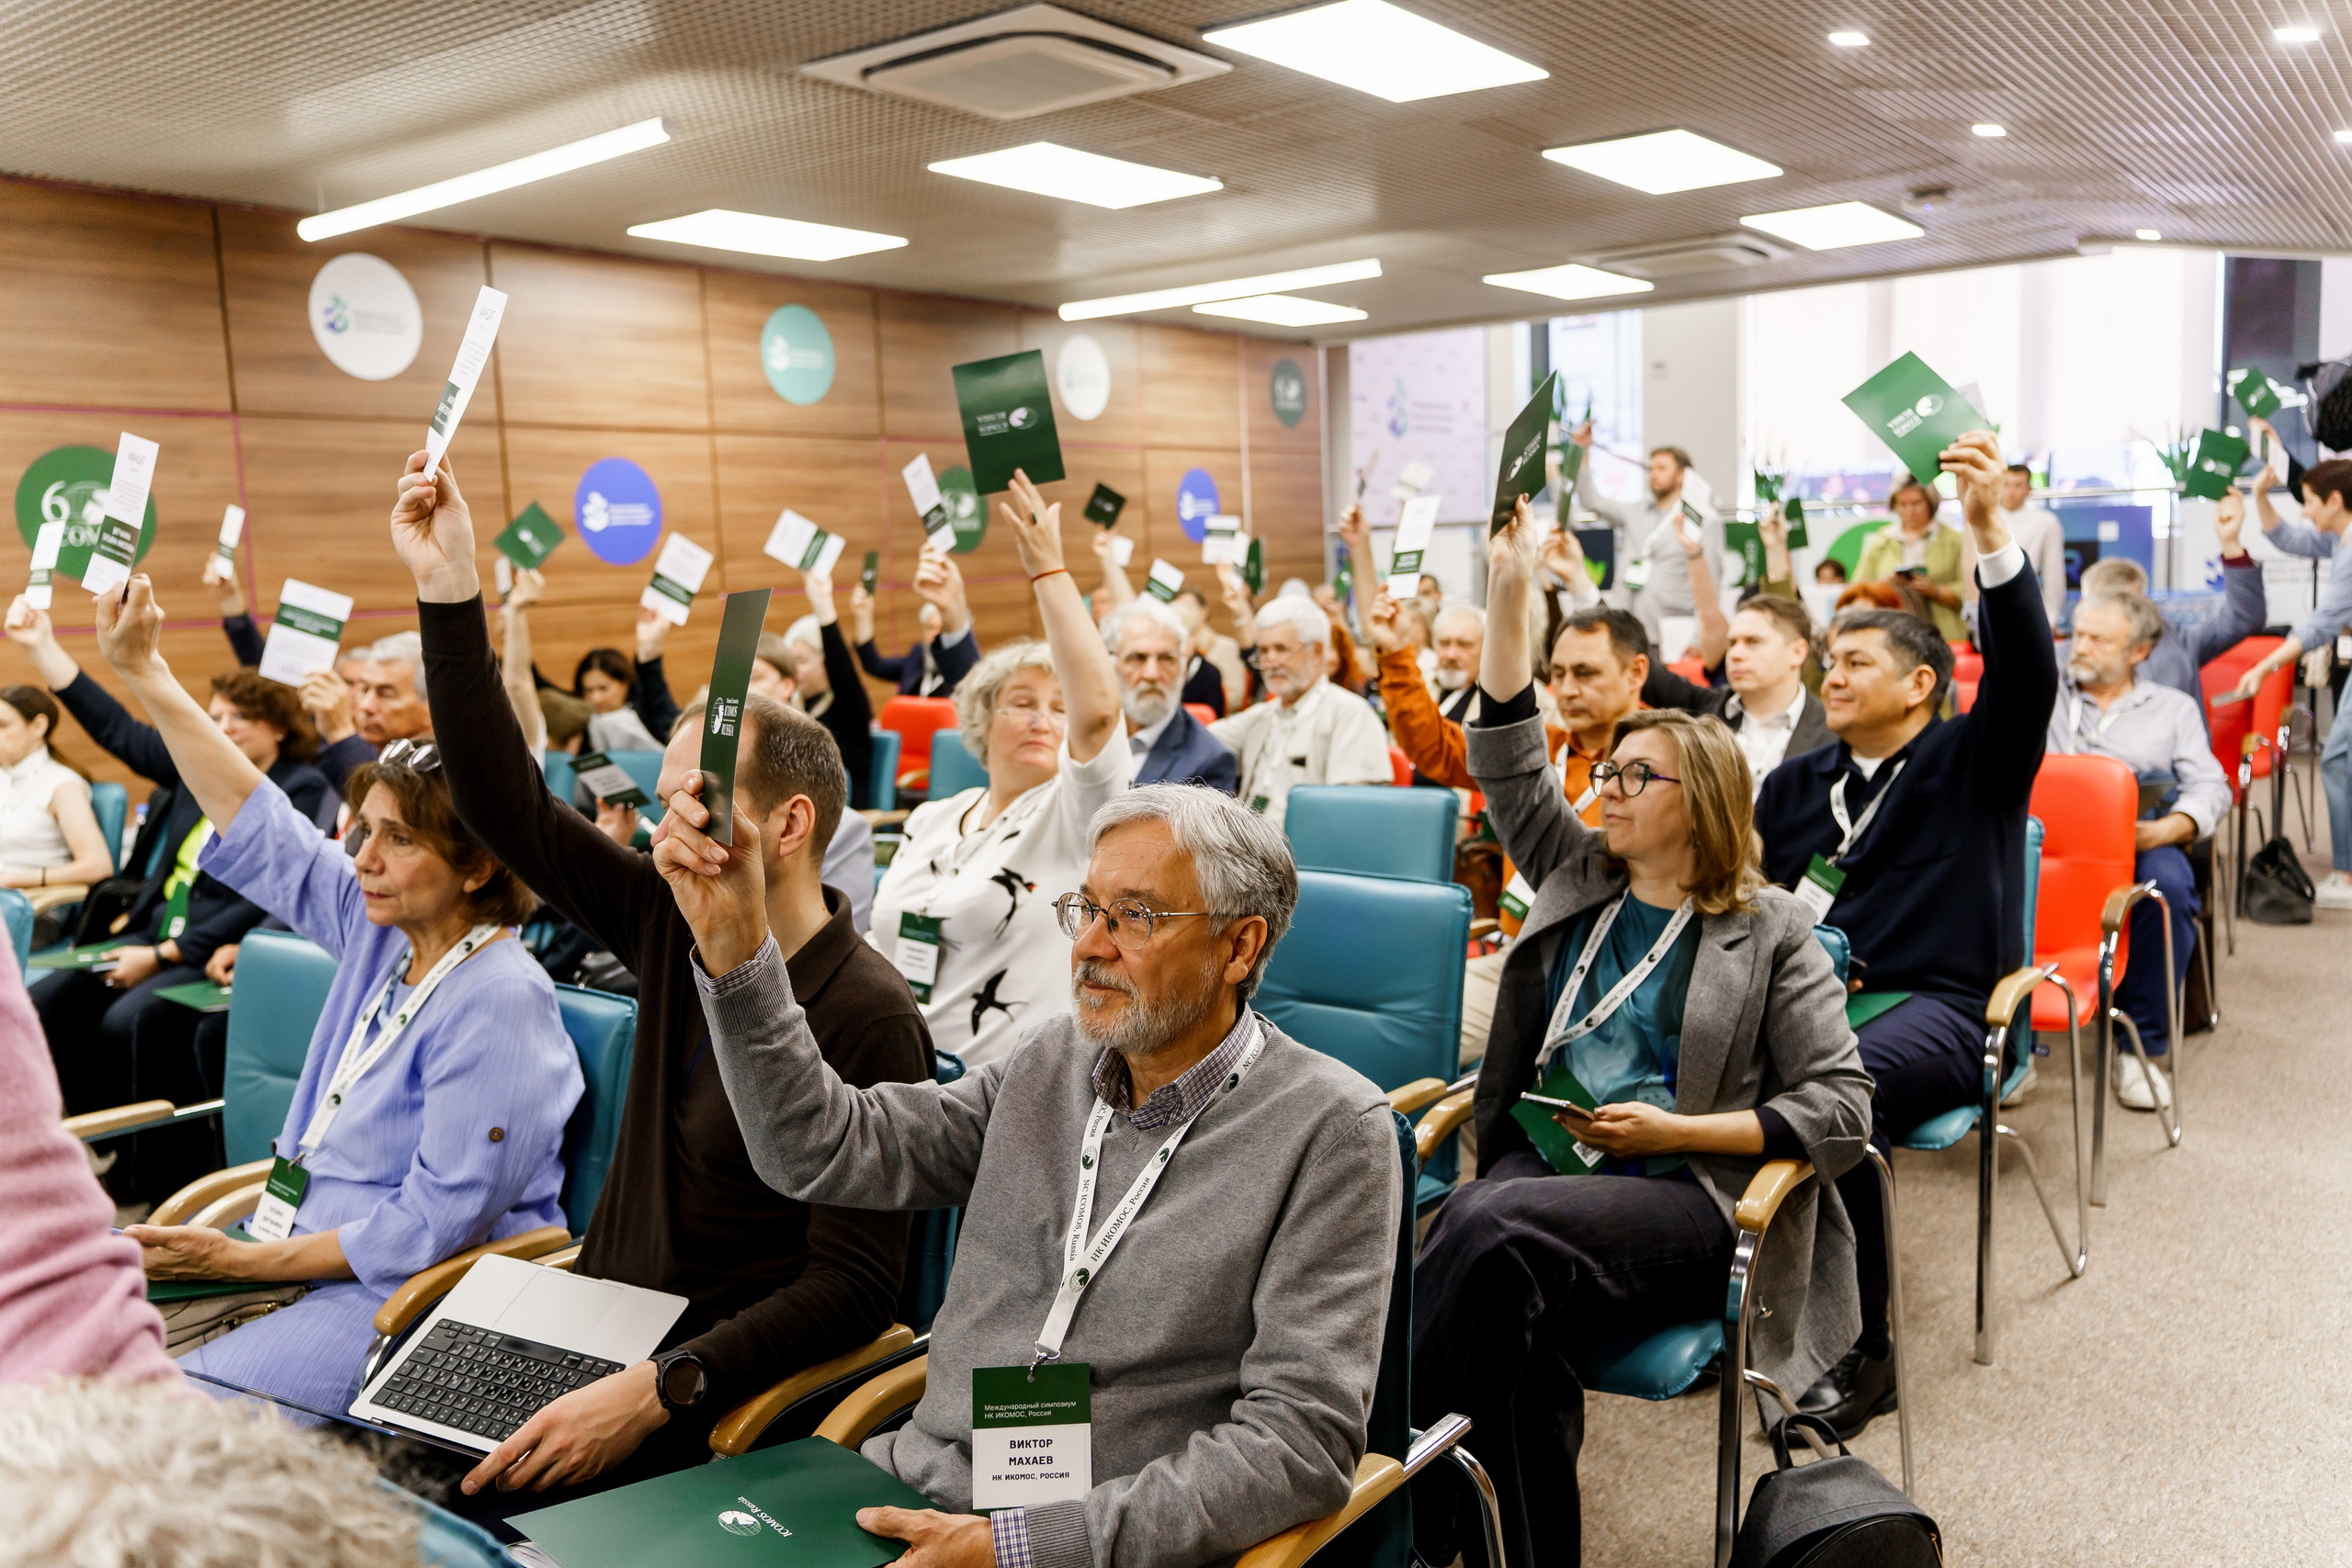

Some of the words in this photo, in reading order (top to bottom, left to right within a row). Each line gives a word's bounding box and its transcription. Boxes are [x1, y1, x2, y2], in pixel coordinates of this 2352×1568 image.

[1089, 1115, 1104, 1138] Россия
[1081, 1179, 1091, 1192] NC
[1073, 1194, 1088, 1232] ICOMOS,
[1091, 1246, 1104, 1262] НК
[1101, 1206, 1134, 1247] ИКОМОС,
[1128, 1177, 1150, 1205] Россия
[1069, 1234, 1080, 1261] Russia
[984, 1403, 1039, 1411] Международный
[995, 1410, 1027, 1419] ИКОМОС,
[1010, 1438, 1053, 1449] ВИКТОР
[1009, 1455, 1054, 1466] МАХАЕВ
[1005, 1472, 1037, 1481] ИКОМОС,
[1039, 1472, 1069, 1480] РОССИЯ
[737, 1495, 762, 1514] Russia
[756, 1512, 794, 1538] ICOMOS
